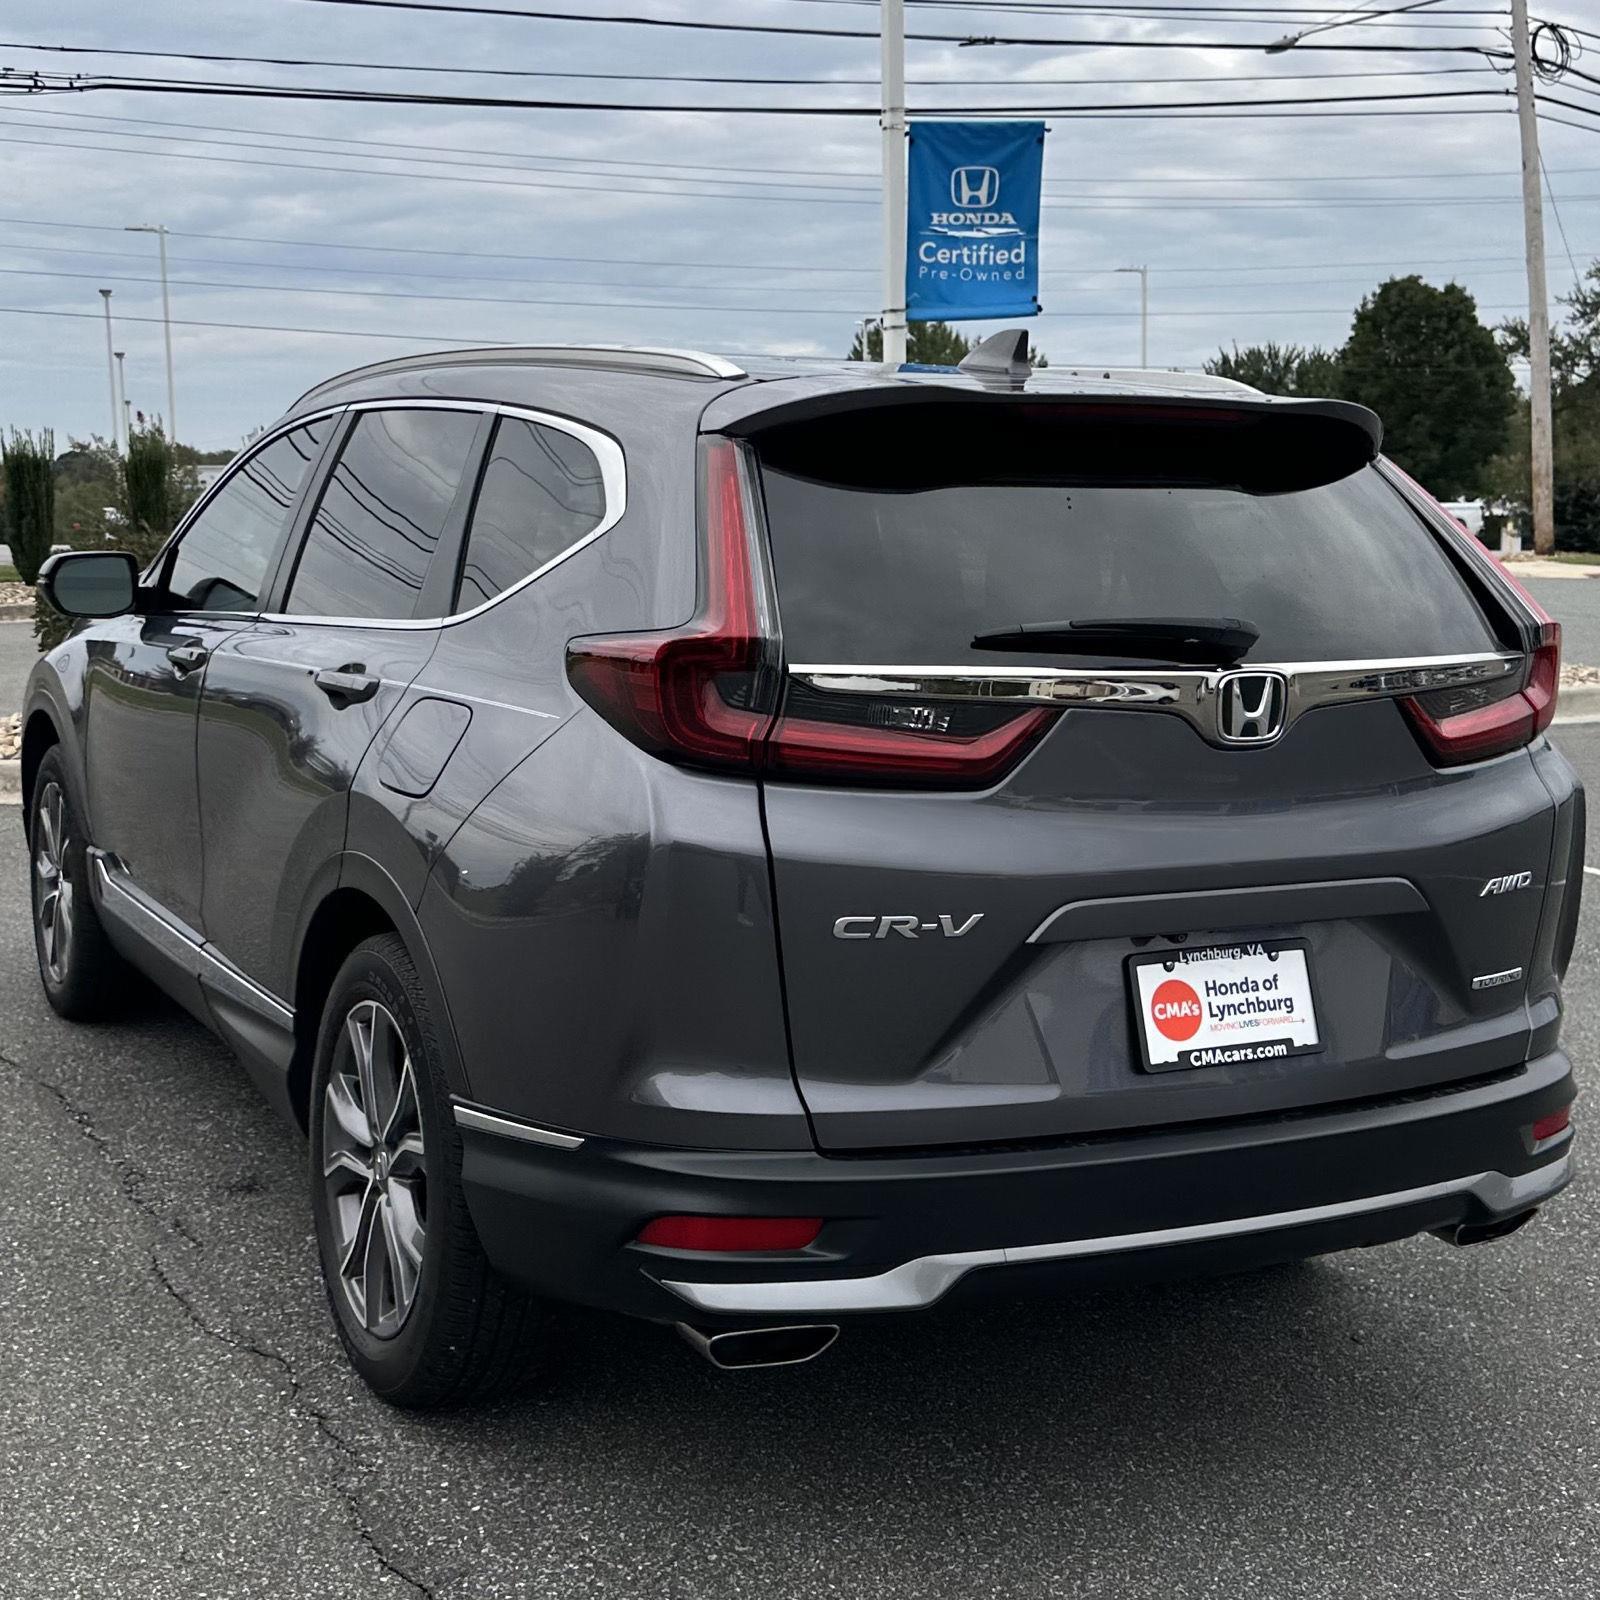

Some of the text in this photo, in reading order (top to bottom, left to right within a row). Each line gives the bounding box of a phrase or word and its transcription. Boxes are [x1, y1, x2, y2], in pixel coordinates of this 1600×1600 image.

[930, 212, 1017, 225] HONDA
[919, 241, 1025, 265] Certified
[919, 266, 1025, 281] Pre-Owned
[1480, 871, 1532, 897] AWD
[833, 913, 985, 939] CR-V
[1247, 944, 1264, 956] VA
[1204, 973, 1279, 997] Honda of
[1153, 1002, 1200, 1020] CMA's
[1207, 996, 1294, 1021] Lynchburg
[1189, 1043, 1288, 1067] CMAcars.com
